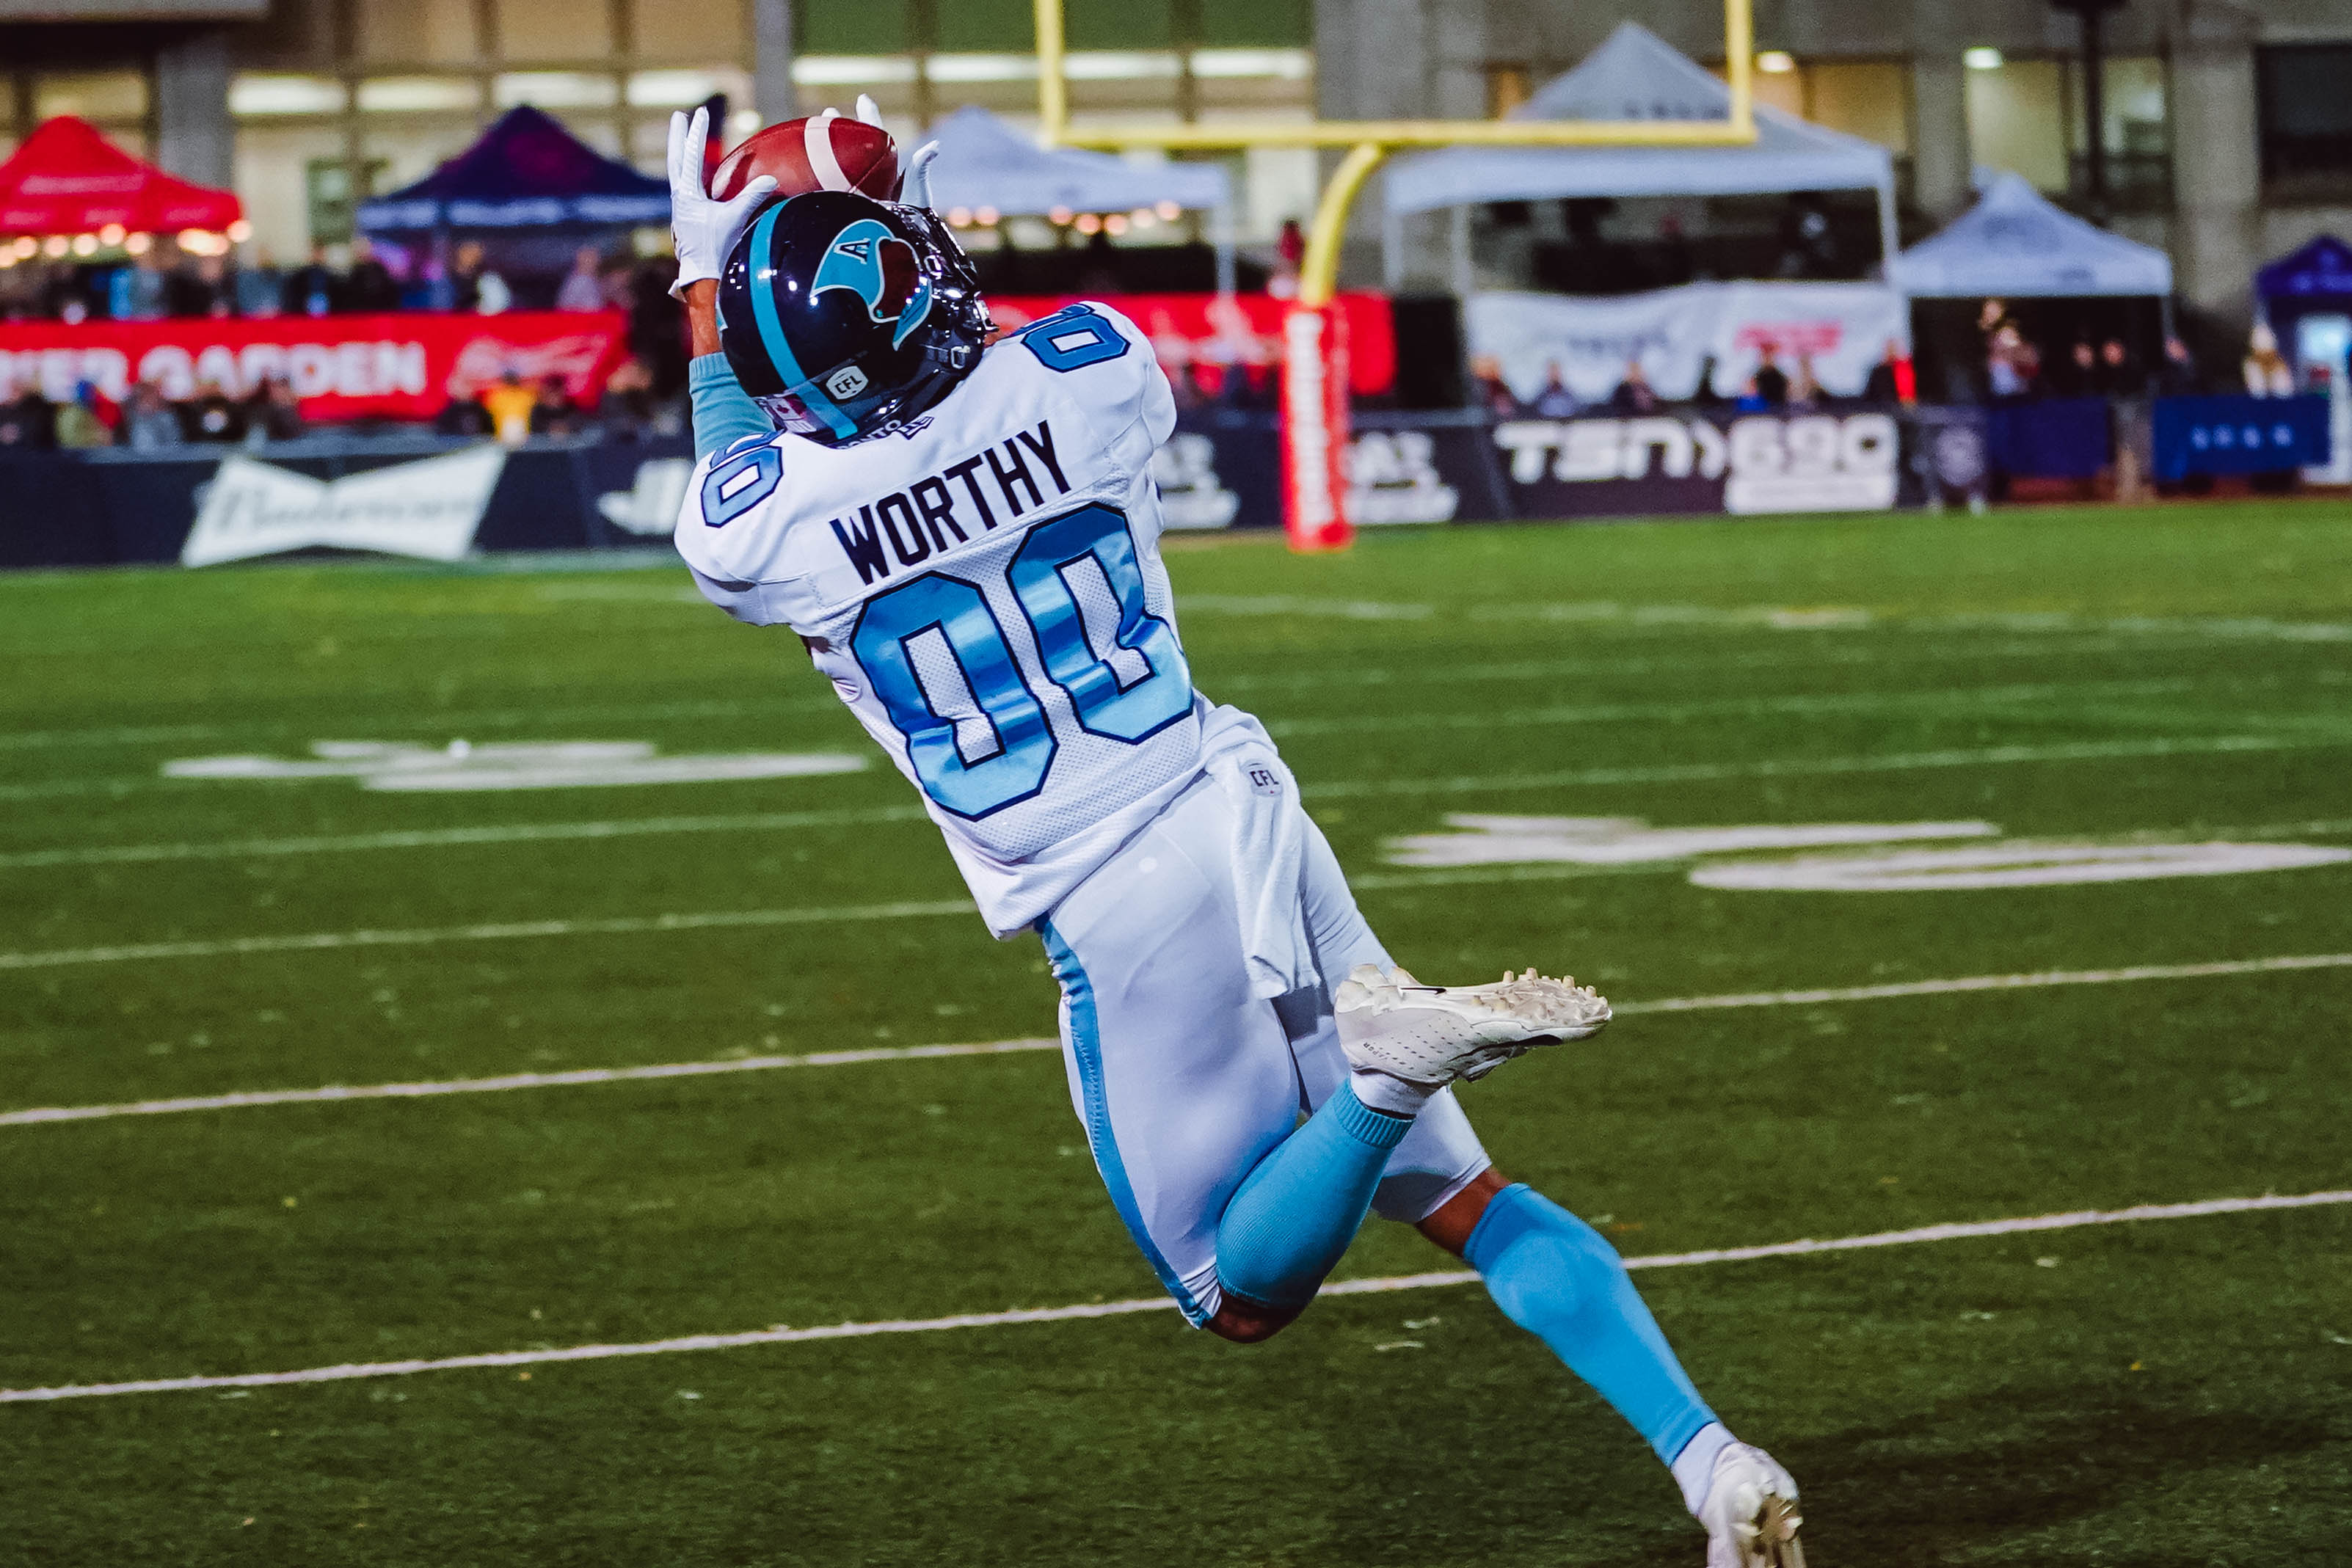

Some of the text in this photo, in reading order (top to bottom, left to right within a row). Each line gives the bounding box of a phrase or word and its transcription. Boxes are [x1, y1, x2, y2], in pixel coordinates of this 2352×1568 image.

[834, 237, 870, 265] A
[834, 374, 862, 394] CFL
[830, 420, 1071, 586] WORTHY
[850, 501, 1194, 822] 00
[1249, 770, 1279, 787] CFL
